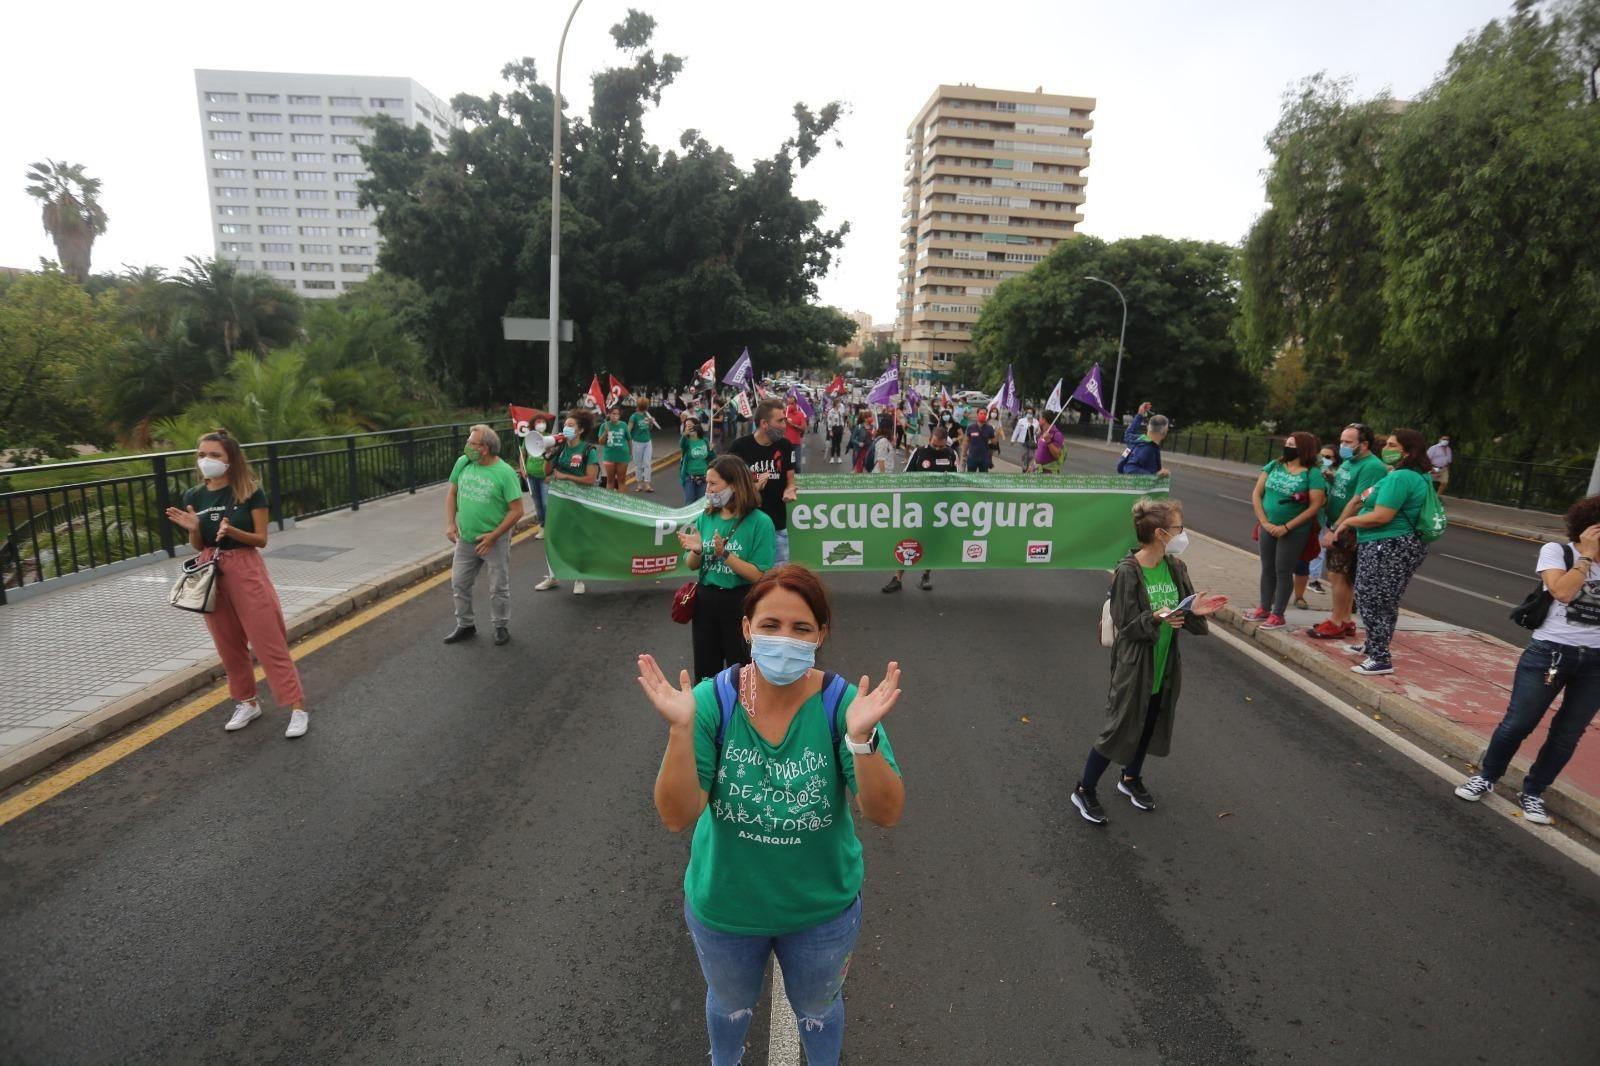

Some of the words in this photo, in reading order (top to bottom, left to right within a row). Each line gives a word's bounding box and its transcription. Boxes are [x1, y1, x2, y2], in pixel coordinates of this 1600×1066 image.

[792, 493, 923, 529] escuela
[932, 501, 1054, 536] segura
[632, 555, 678, 568] CCOO
[774, 752, 828, 780] PÚBLICA:
[729, 782, 754, 799] DE
[762, 788, 821, 807] TOD@S
[716, 809, 763, 827] PARA
[770, 814, 833, 832] TOD@S
[738, 830, 802, 845] AXARQUÍA
